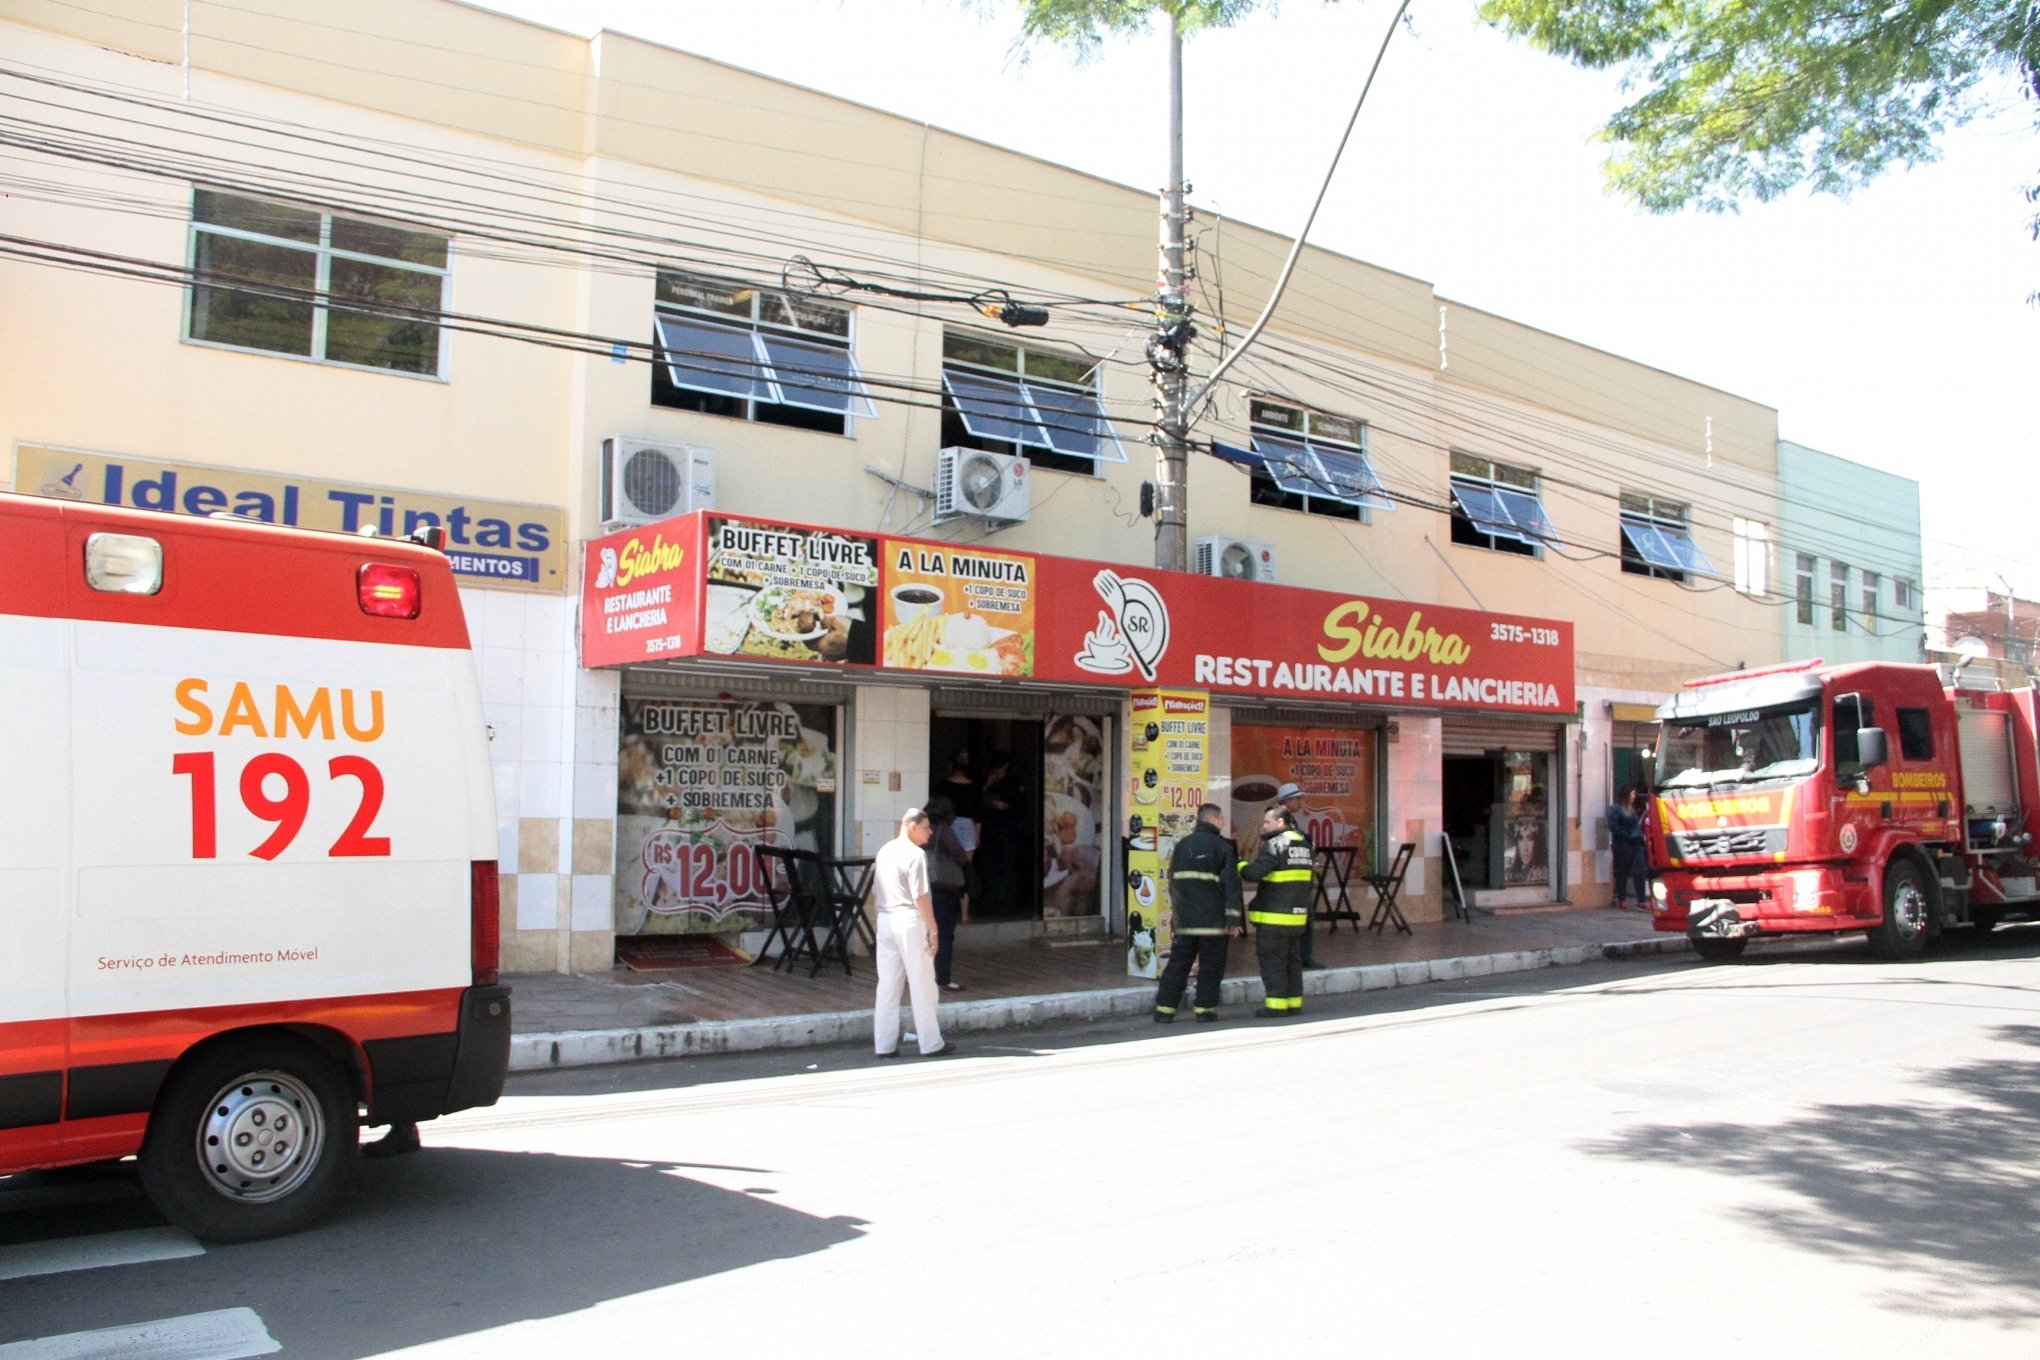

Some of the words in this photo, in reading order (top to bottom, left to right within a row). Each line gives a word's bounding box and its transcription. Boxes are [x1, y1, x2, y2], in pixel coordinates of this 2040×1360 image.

[104, 464, 299, 526] Ideal
[328, 490, 550, 552] Tintas
[723, 529, 801, 557] BUFFET
[809, 540, 865, 565] LIVRE
[617, 533, 684, 586] Siabra
[721, 558, 742, 568] COM
[746, 561, 755, 570] 01
[758, 562, 787, 574] CARNE
[807, 568, 828, 578] COPO
[831, 571, 841, 580] DE
[845, 571, 866, 582] SUCO
[898, 551, 912, 570] A
[921, 553, 944, 574] LA
[952, 557, 1026, 582] MINUTA
[773, 576, 825, 590] SOBREMESA
[974, 585, 993, 596] COPO
[996, 587, 1005, 597] DE
[1007, 588, 1027, 599] SUCO
[604, 584, 671, 614] RESTAURANTE
[977, 600, 1020, 612] SOBREMESA
[607, 616, 613, 634] E
[614, 607, 667, 633] LANCHERIA
[1128, 615, 1150, 633] SR
[1317, 600, 1471, 665] Siabra
[1491, 622, 1559, 646] 3575-1318
[1194, 654, 1404, 698] RESTAURANTE
[1411, 672, 1424, 699] E
[1431, 674, 1560, 707] LANCHERIA
[174, 678, 385, 742] SAMU
[646, 708, 728, 733] BUFFET
[736, 711, 796, 736] LIVRE
[1723, 711, 1759, 725] LEOPOLDO
[1161, 721, 1185, 733] BUFFET
[1188, 722, 1206, 734] LIVRE
[664, 747, 700, 763] COM
[706, 748, 721, 763] 01
[728, 749, 777, 765] CARNE
[1283, 738, 1292, 756] A
[1297, 739, 1310, 756] LA
[1316, 740, 1360, 758] MINUTA
[656, 769, 672, 784] +1
[679, 769, 716, 785] COPO
[723, 770, 741, 786] DE
[747, 771, 786, 787] SUCO
[1302, 764, 1321, 777] COPO
[1324, 765, 1333, 777] DE
[1335, 765, 1355, 777] SUCO
[1892, 771, 1946, 788] BOMBEIROS
[172, 751, 391, 861] 192
[683, 792, 774, 809] SOBREMESA
[1171, 786, 1202, 810] 12,00
[654, 843, 673, 864] R$
[97, 955, 154, 971] Serviço
[158, 953, 177, 967] de
[181, 950, 273, 966] Atendimento
[277, 947, 319, 962] Móvel
